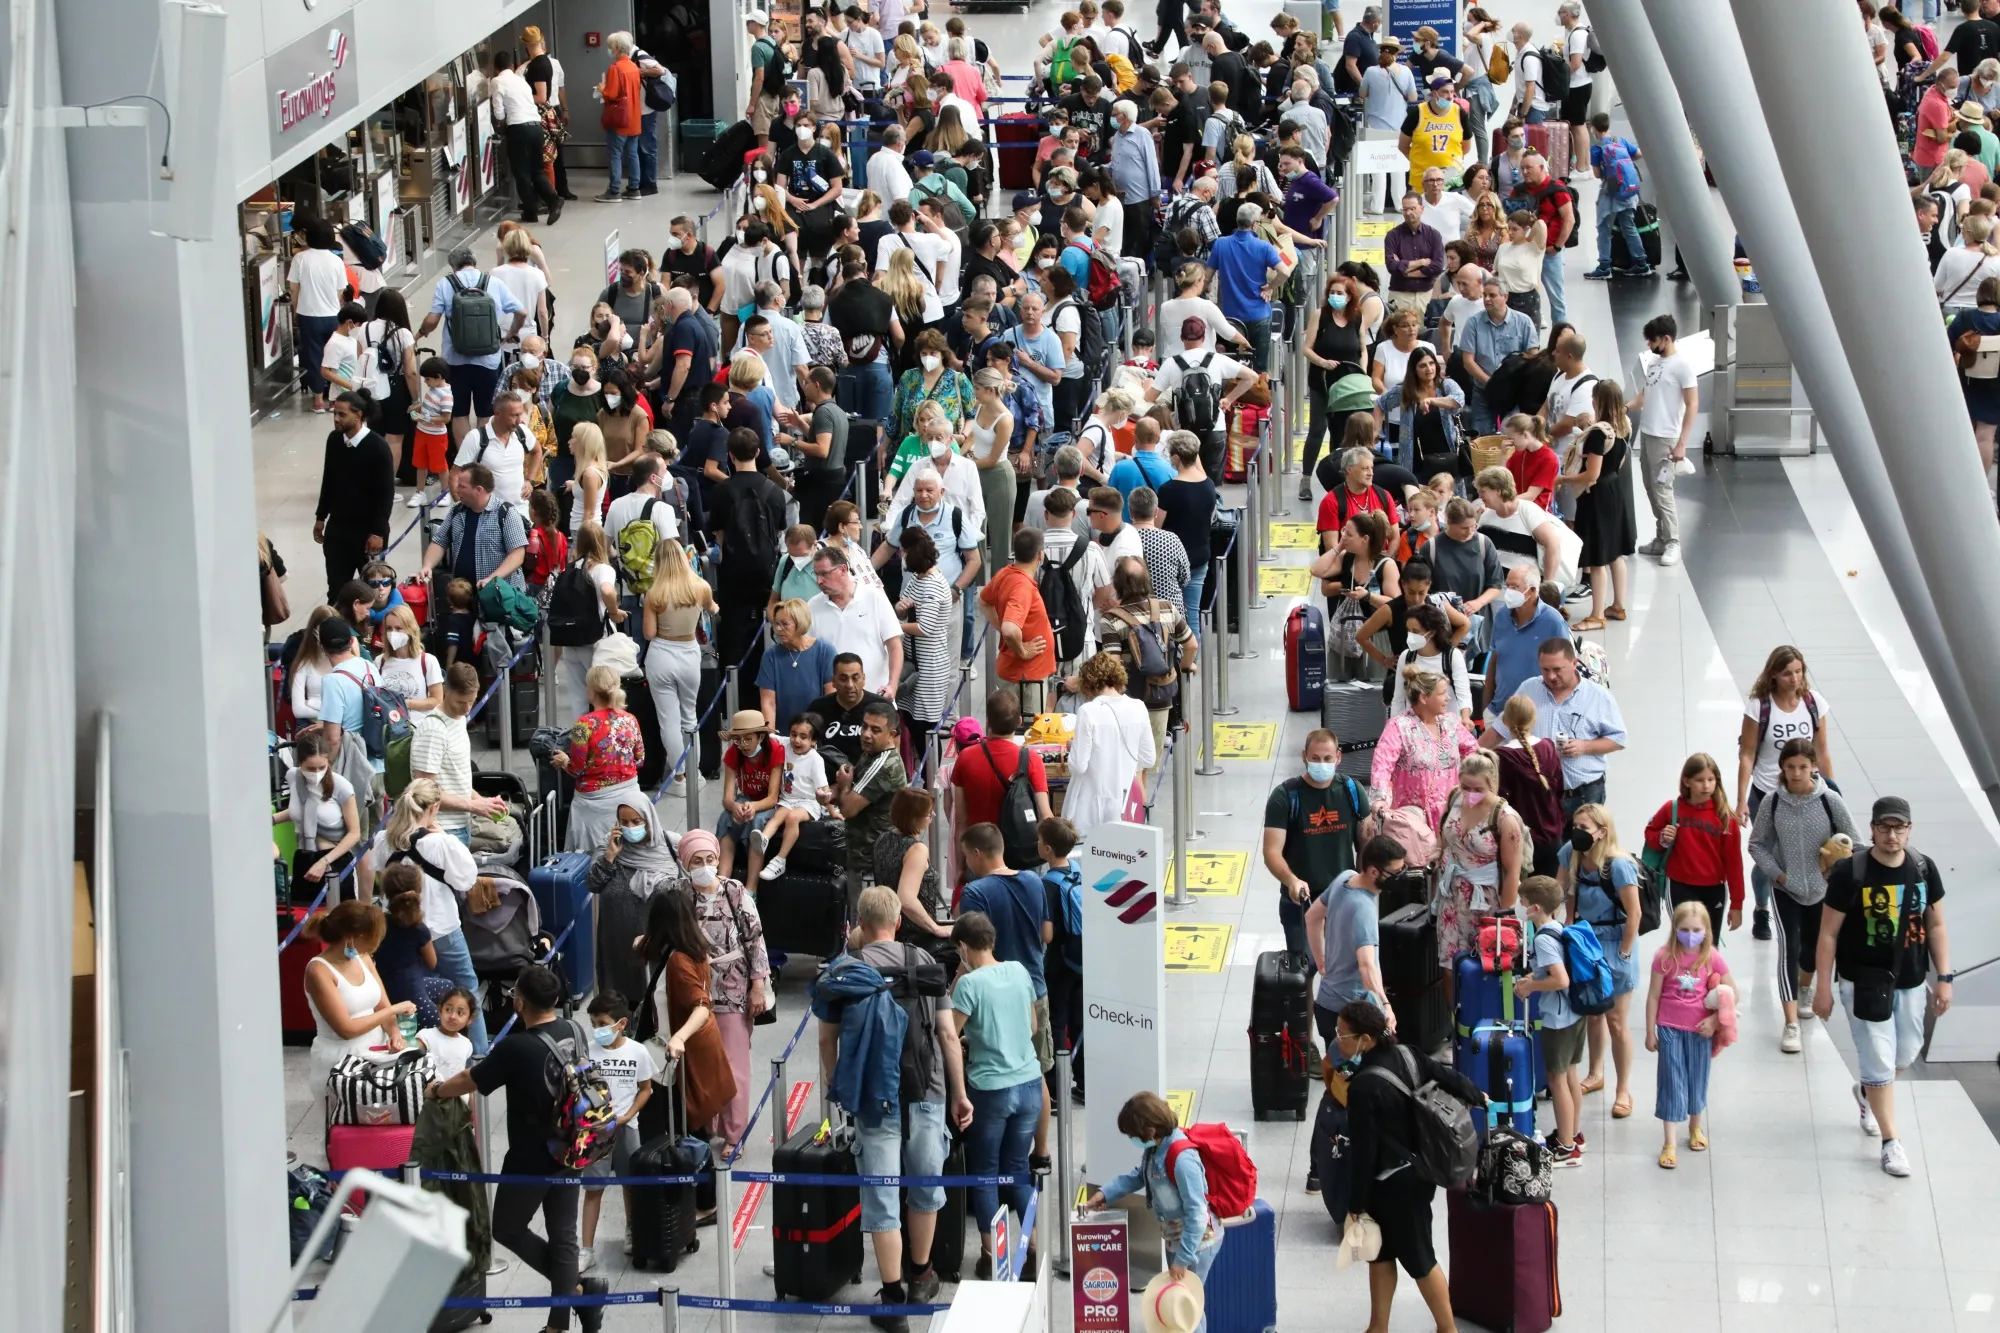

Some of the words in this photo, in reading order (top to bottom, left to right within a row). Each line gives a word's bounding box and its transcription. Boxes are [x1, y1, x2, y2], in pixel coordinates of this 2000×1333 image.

[276, 71, 335, 132] Eurowings
[1424, 122, 1454, 132] LAKERS
[1432, 134, 1449, 152] 17
[1370, 153, 1397, 161] Ausgang
[1091, 846, 1137, 865] Eurowings
[1089, 1003, 1153, 1030] Check-in
[770, 1174, 786, 1182] DUS
[884, 1177, 899, 1185] DUS
[998, 1176, 1014, 1184] DUS
[1076, 1233, 1112, 1242] Eurowings
[1077, 1243, 1091, 1252] WE
[1100, 1243, 1122, 1252] CARE
[1084, 1280, 1118, 1289] SAGROTAN
[627, 1294, 644, 1302] DUS
[504, 1299, 522, 1307] DUS
[713, 1299, 730, 1308] DUS
[834, 1305, 851, 1313] DUS
[1084, 1305, 1118, 1318] PRO
